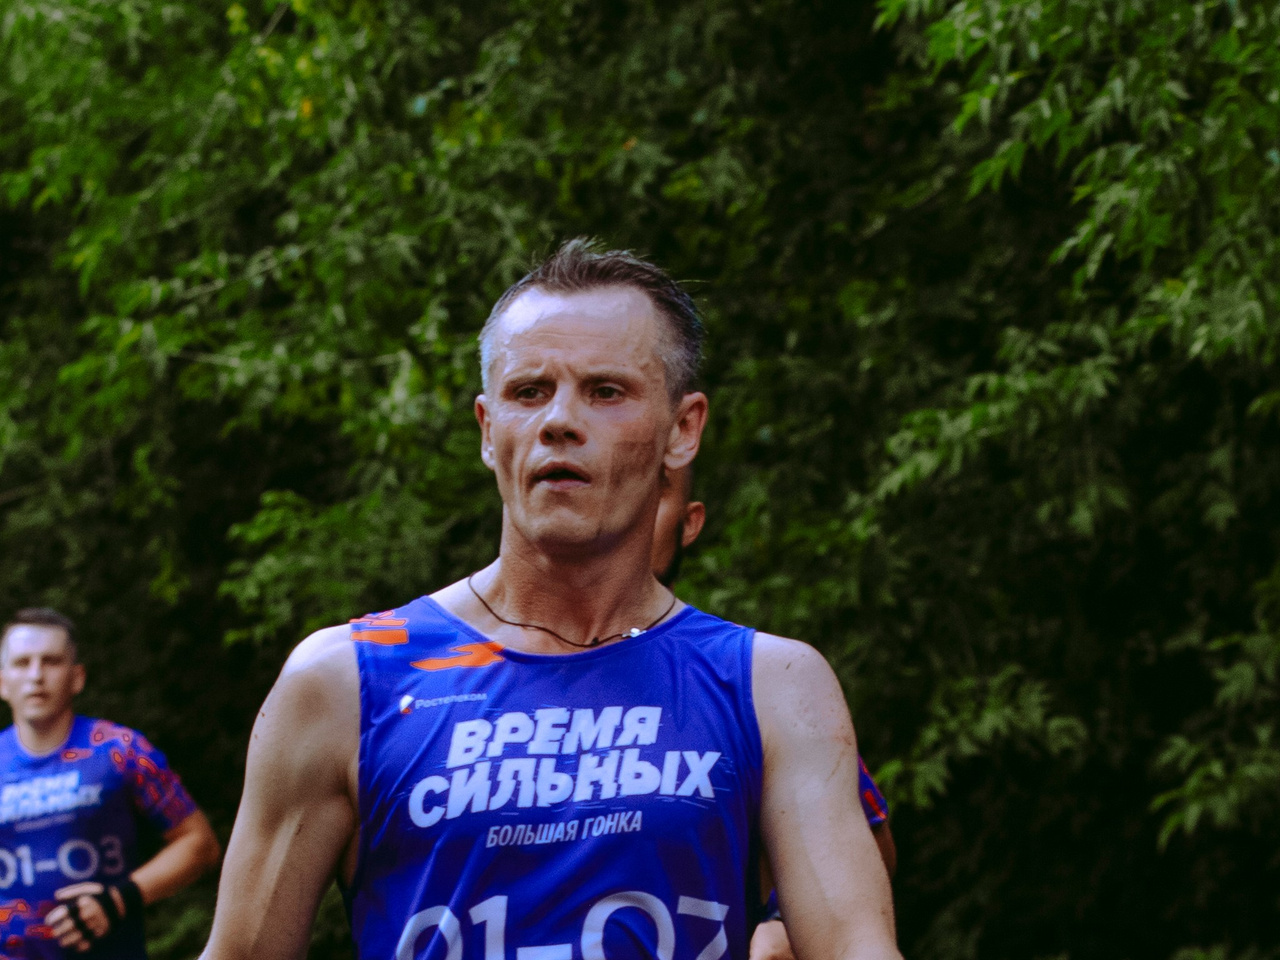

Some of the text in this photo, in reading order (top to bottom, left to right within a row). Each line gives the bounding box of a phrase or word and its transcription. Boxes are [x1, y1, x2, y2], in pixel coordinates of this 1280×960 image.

[447, 706, 662, 768] ВРЕМЯ
[409, 749, 722, 828] СИЛЬНЫХ
[486, 811, 643, 848] БОЛЬШАЯ ГОНКА
